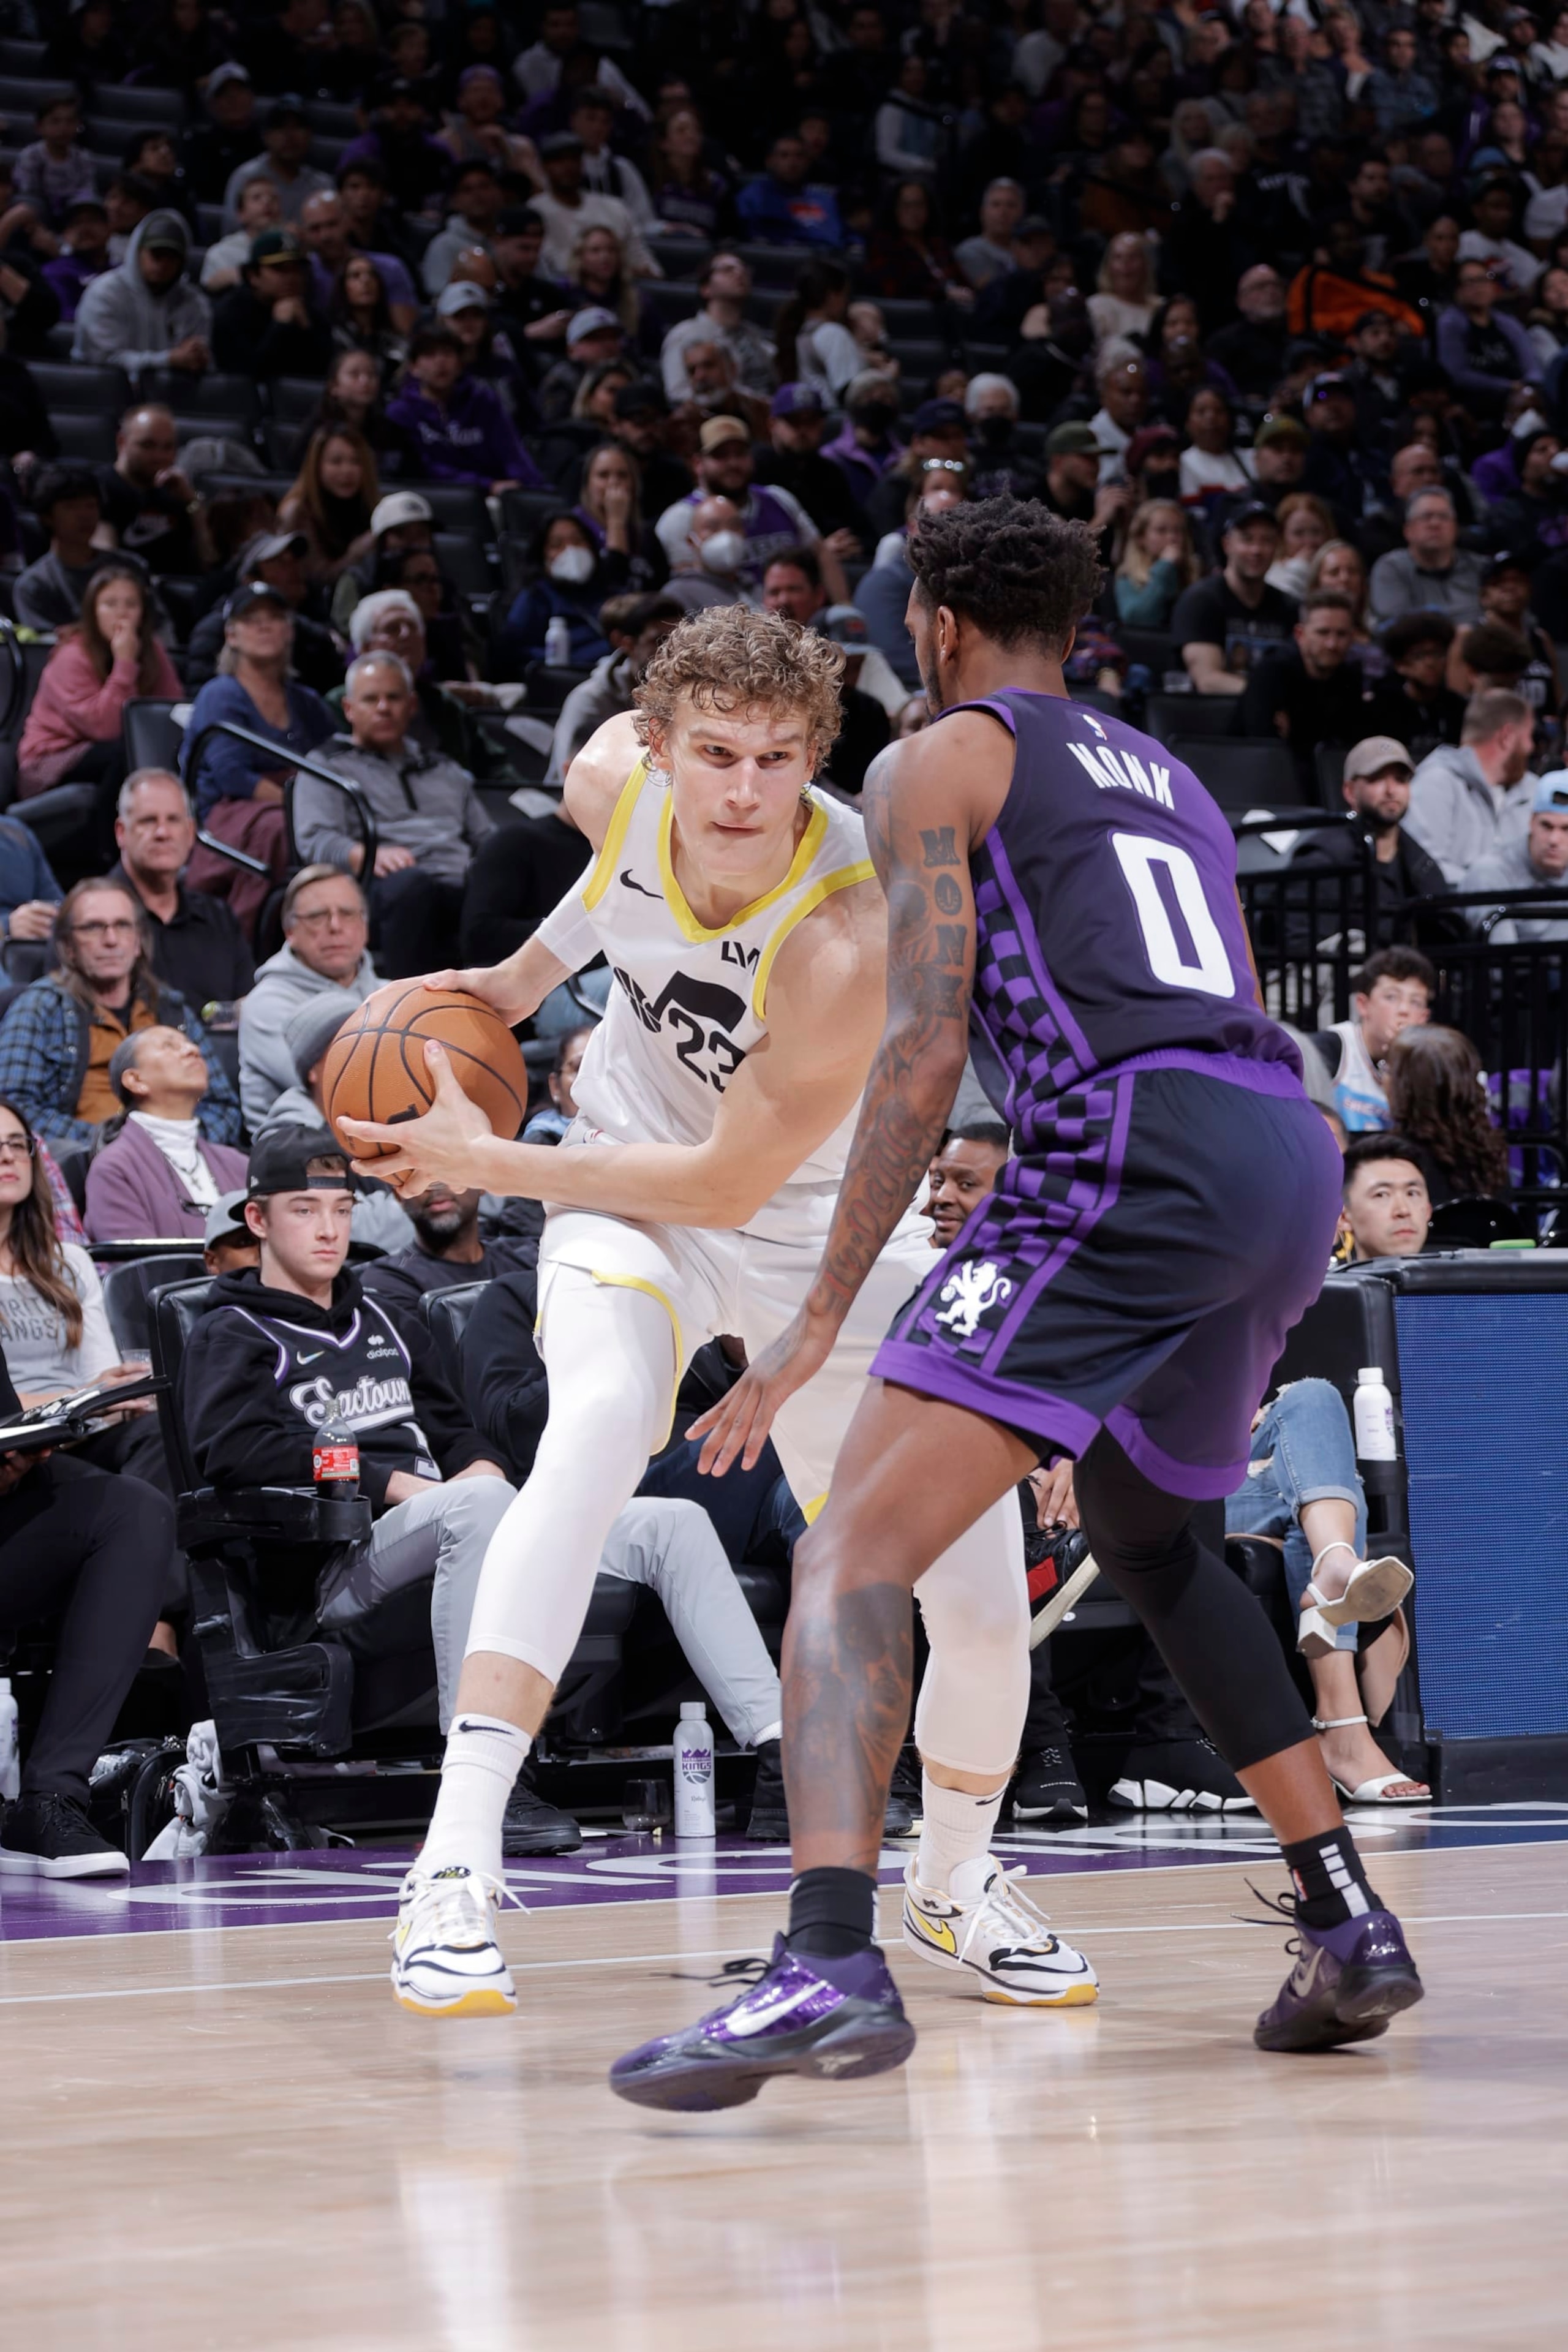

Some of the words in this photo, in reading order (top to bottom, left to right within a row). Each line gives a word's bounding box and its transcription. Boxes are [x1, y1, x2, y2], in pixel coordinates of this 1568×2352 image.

[1066, 742, 1175, 810] MONK
[1112, 832, 1235, 998] 0
[668, 1008, 746, 1094] 23
[682, 1762, 712, 1771] KINGS
